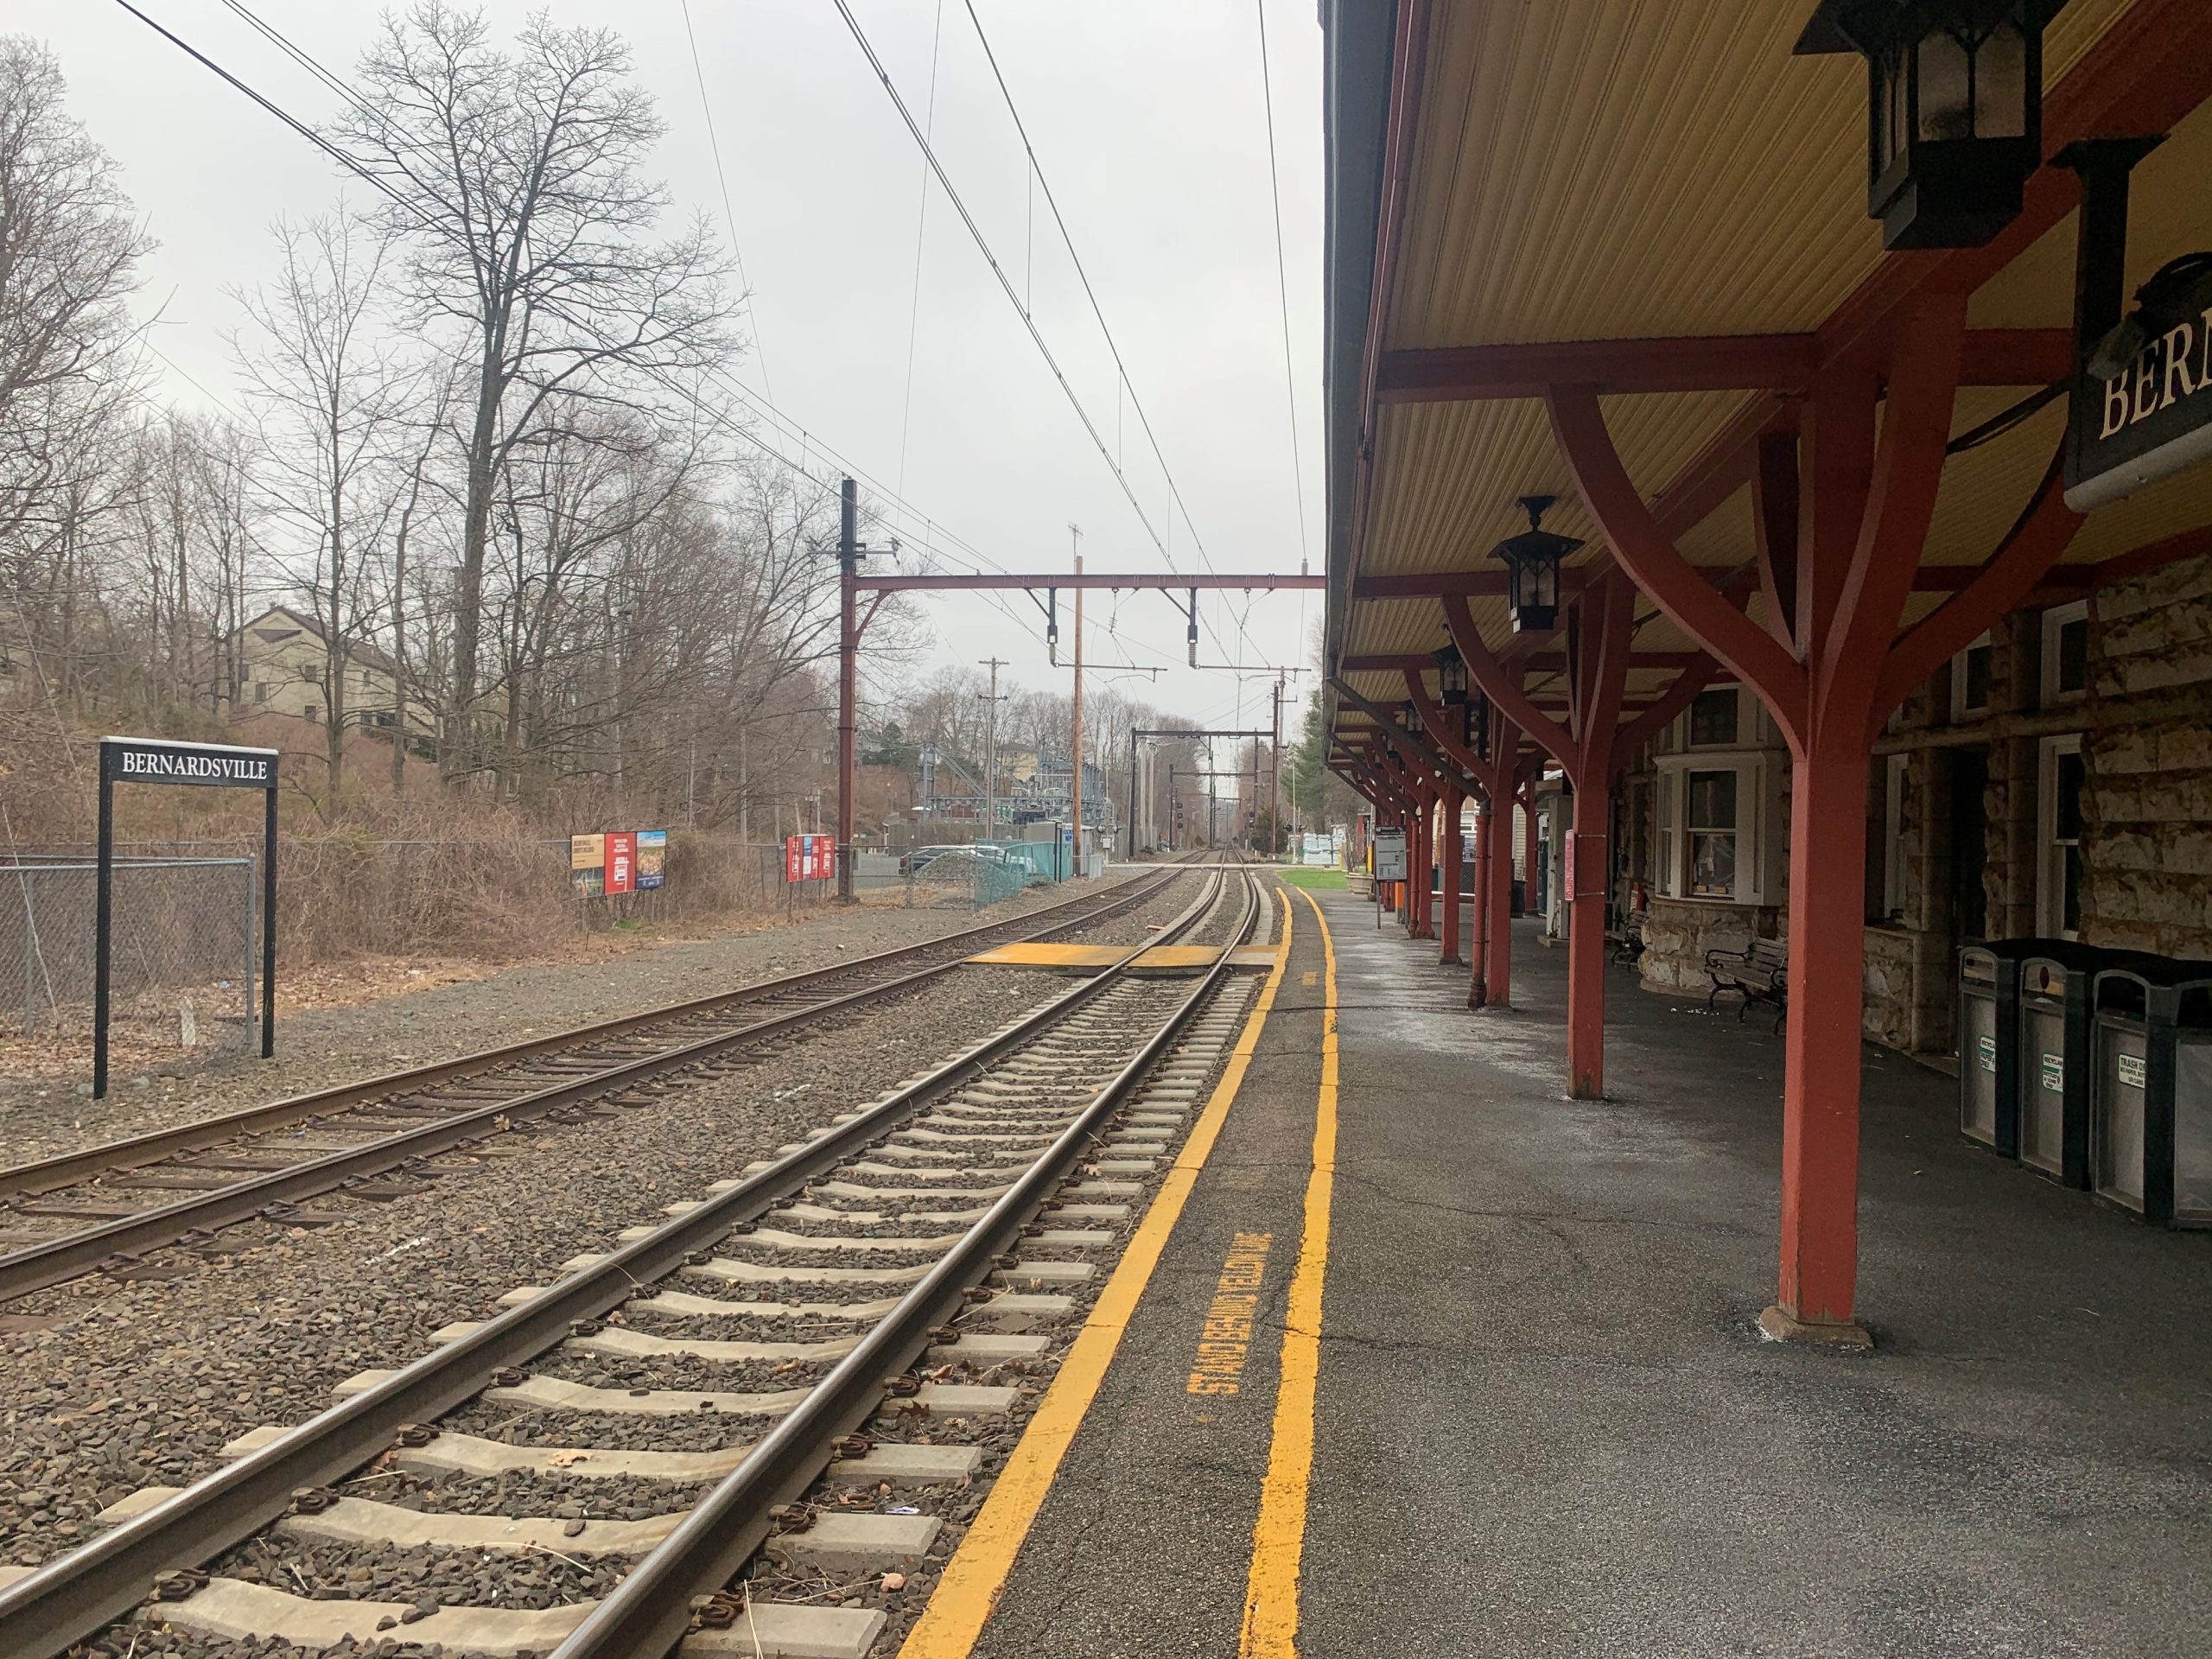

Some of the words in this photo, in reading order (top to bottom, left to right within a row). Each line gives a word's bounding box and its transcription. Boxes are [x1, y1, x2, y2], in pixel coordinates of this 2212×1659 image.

[122, 751, 268, 780] BERNARDSVILLE
[2120, 1057, 2138, 1071] TRASH
[1186, 1343, 1247, 1395] STAND
